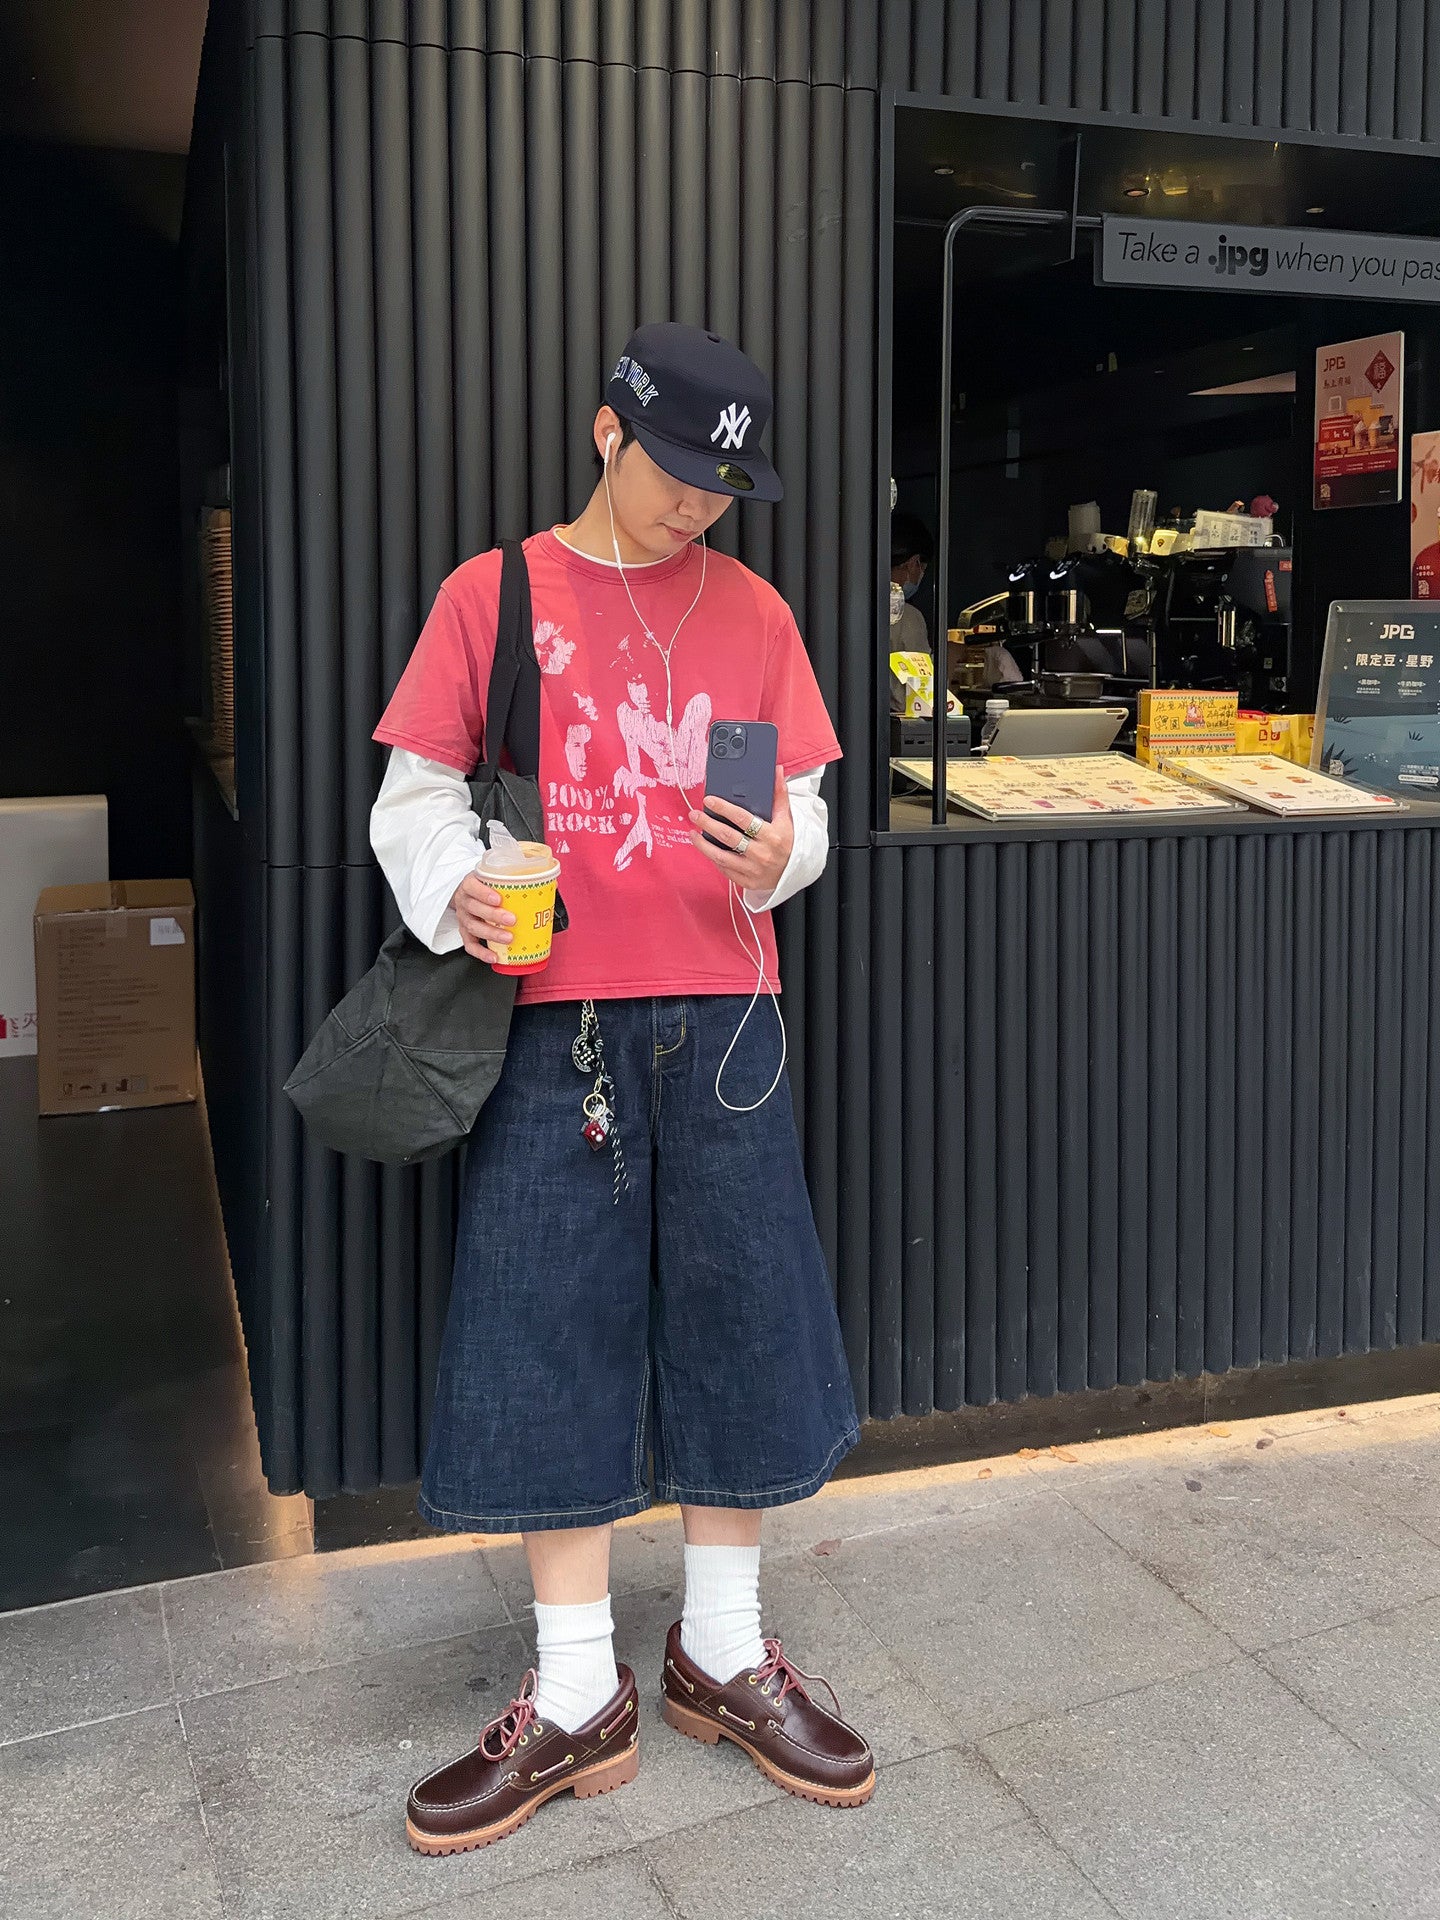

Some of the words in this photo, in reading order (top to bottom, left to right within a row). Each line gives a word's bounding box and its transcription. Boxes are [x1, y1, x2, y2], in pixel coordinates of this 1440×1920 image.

[1118, 232, 1178, 264] Take
[1184, 245, 1200, 264] a
[1208, 234, 1269, 277] .jpg
[1276, 242, 1344, 273] when
[1349, 254, 1396, 283] you
[1323, 355, 1346, 372] JPG
[625, 359, 660, 408] YORK
[710, 402, 752, 450] NY
[1379, 624, 1415, 640] JPG
[547, 782, 615, 811] 100%
[547, 812, 617, 835] ROCK
